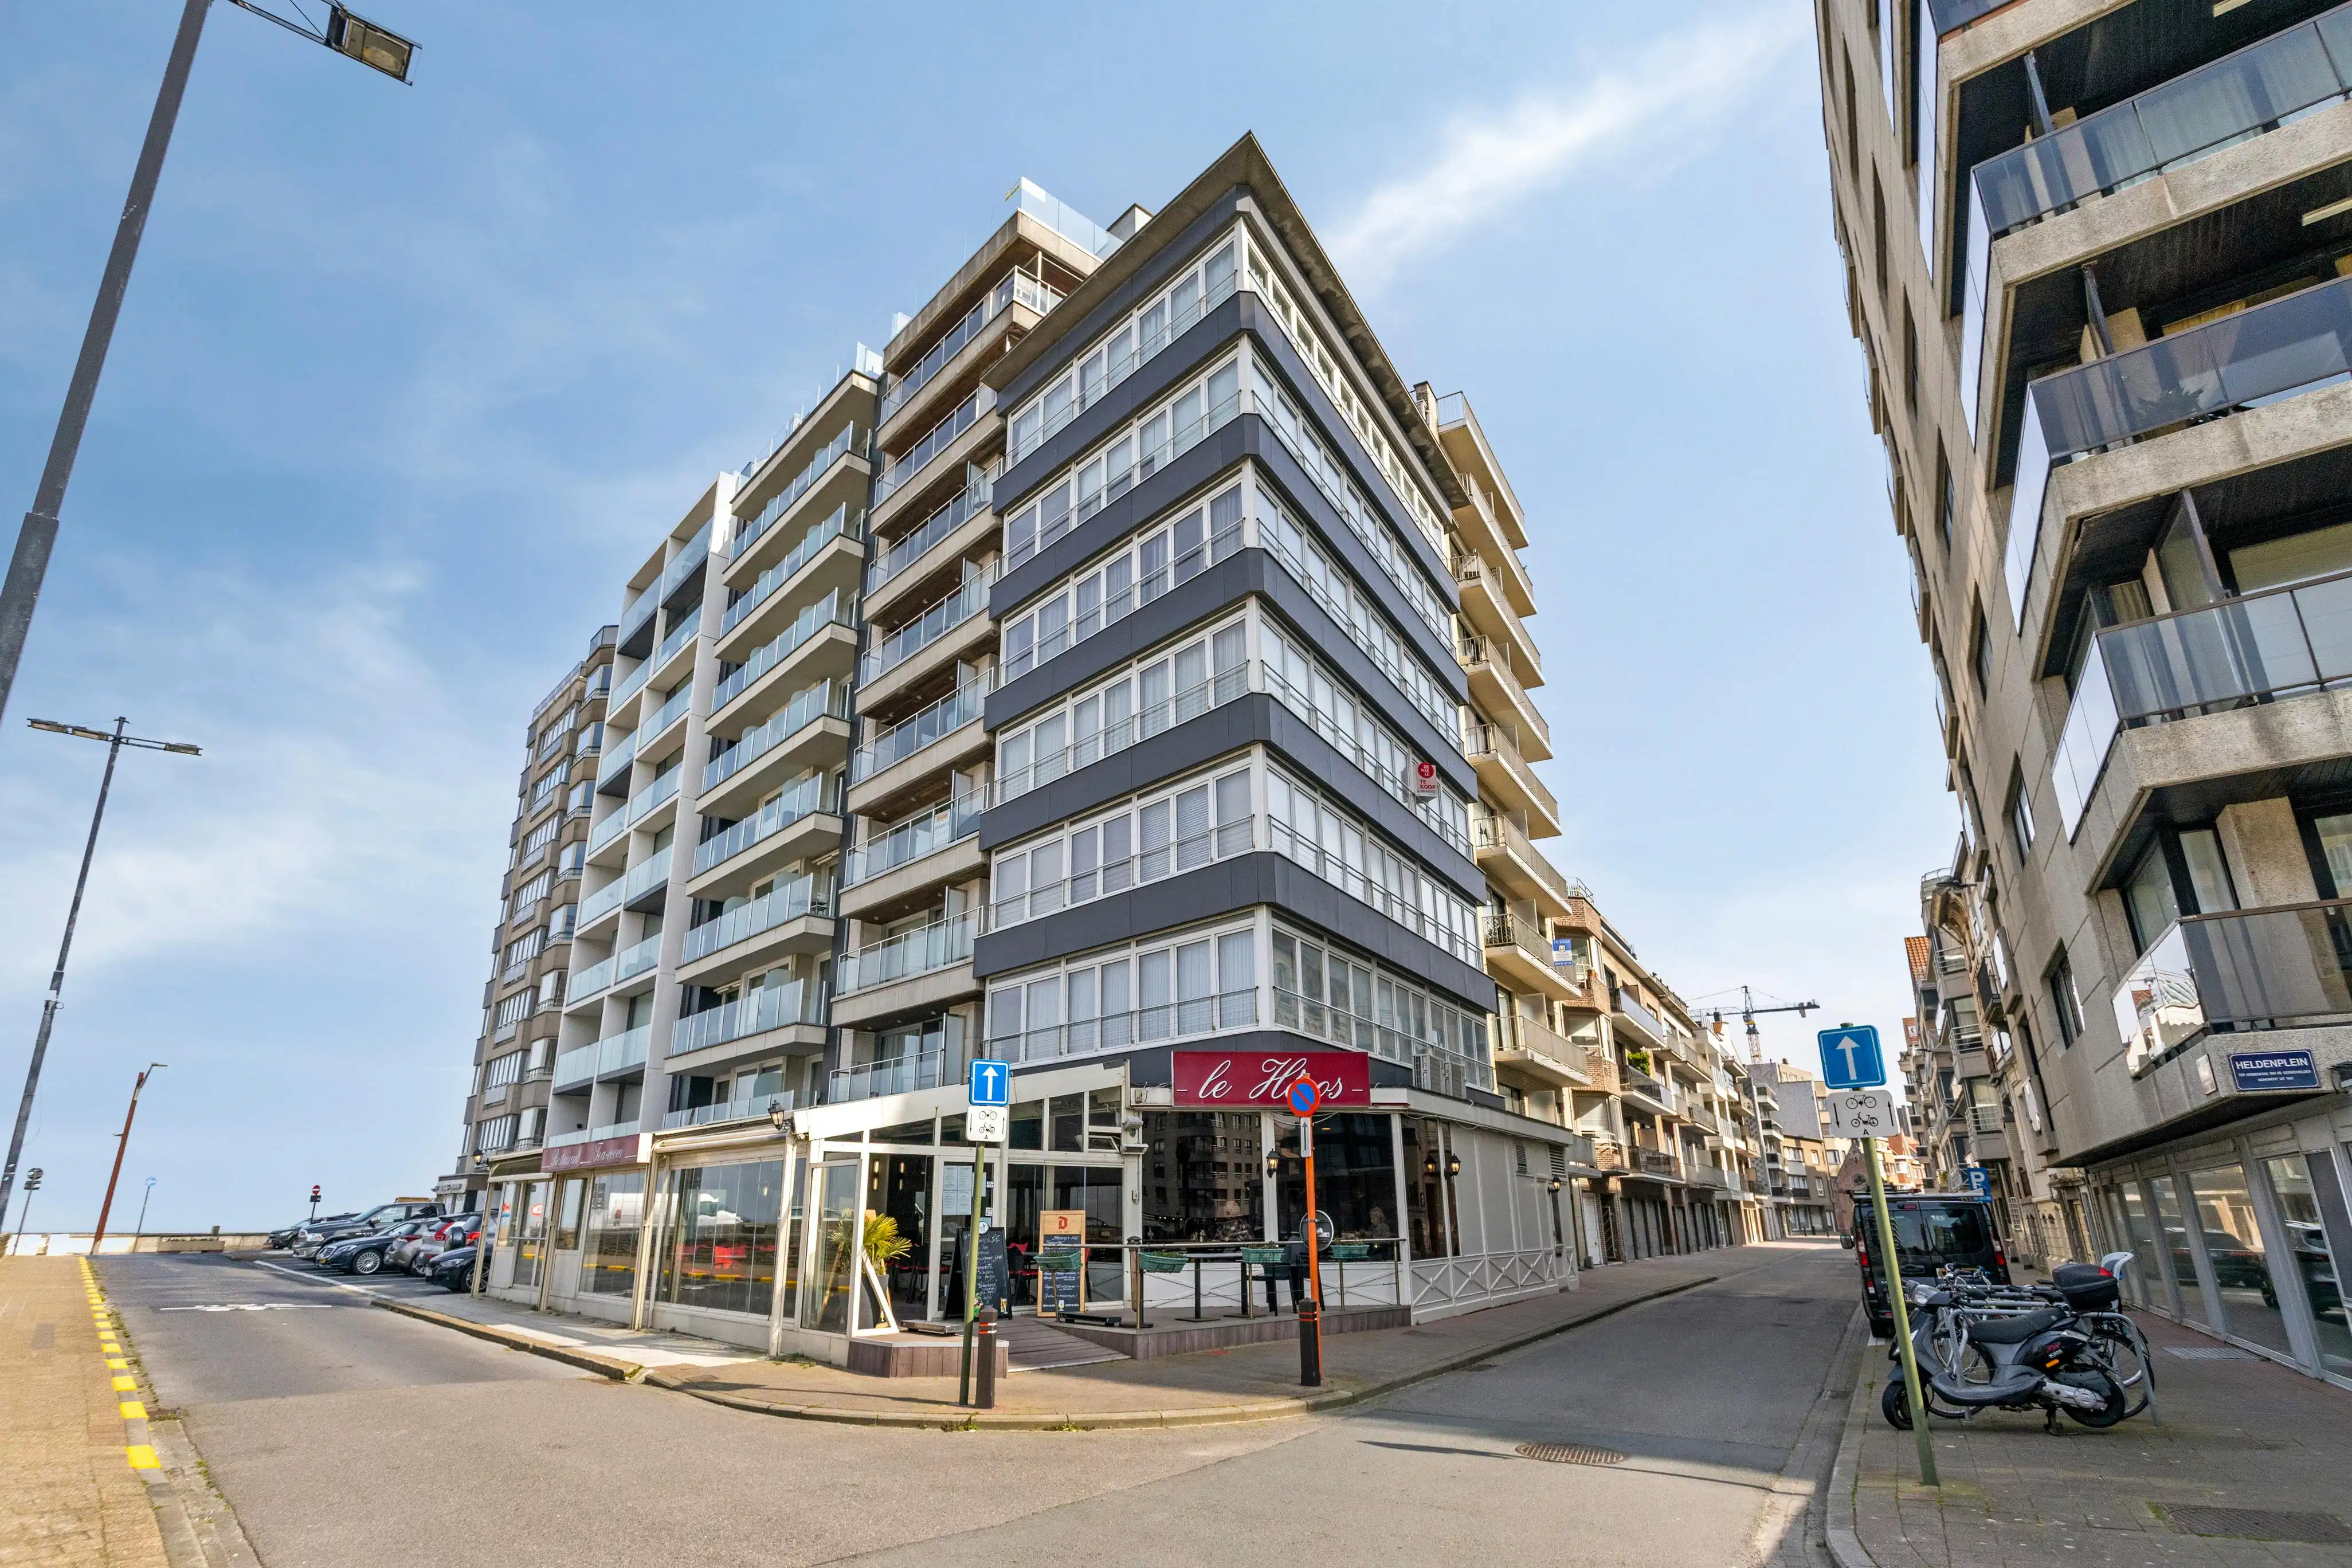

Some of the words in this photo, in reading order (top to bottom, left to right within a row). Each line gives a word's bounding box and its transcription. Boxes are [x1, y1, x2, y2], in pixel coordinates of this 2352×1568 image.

[2235, 1057, 2308, 1069] HELDENPLEIN
[1198, 1060, 1233, 1099] le
[1970, 1171, 1985, 1189] P
